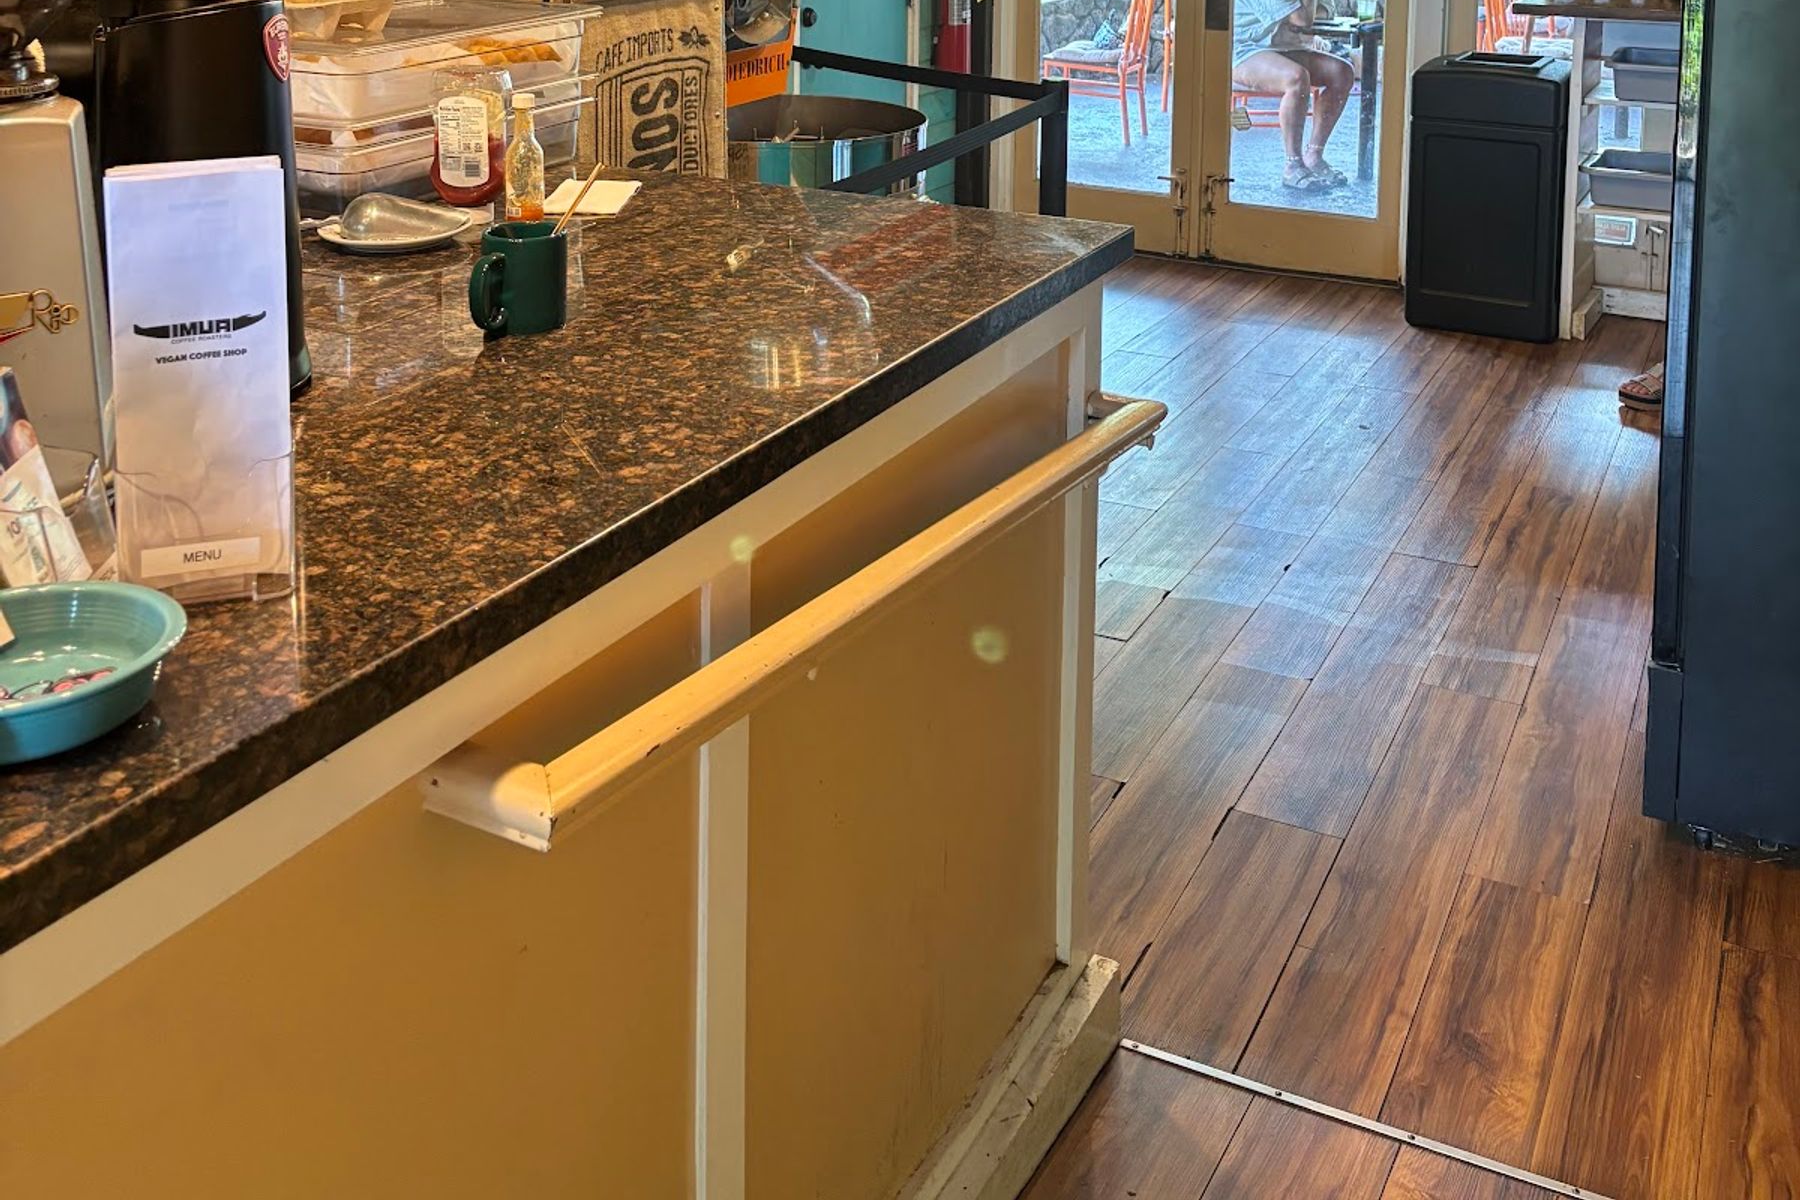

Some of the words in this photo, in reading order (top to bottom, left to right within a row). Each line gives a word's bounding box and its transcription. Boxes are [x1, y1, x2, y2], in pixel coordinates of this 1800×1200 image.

[595, 42, 624, 73] CAFE
[626, 28, 674, 63] IMPORTS
[171, 318, 232, 338] IMUA
[171, 336, 196, 345] COFFEE
[155, 353, 187, 365] VEGAN
[189, 350, 222, 361] COFFEE
[223, 348, 248, 358] SHOP
[183, 549, 222, 563] MENU
